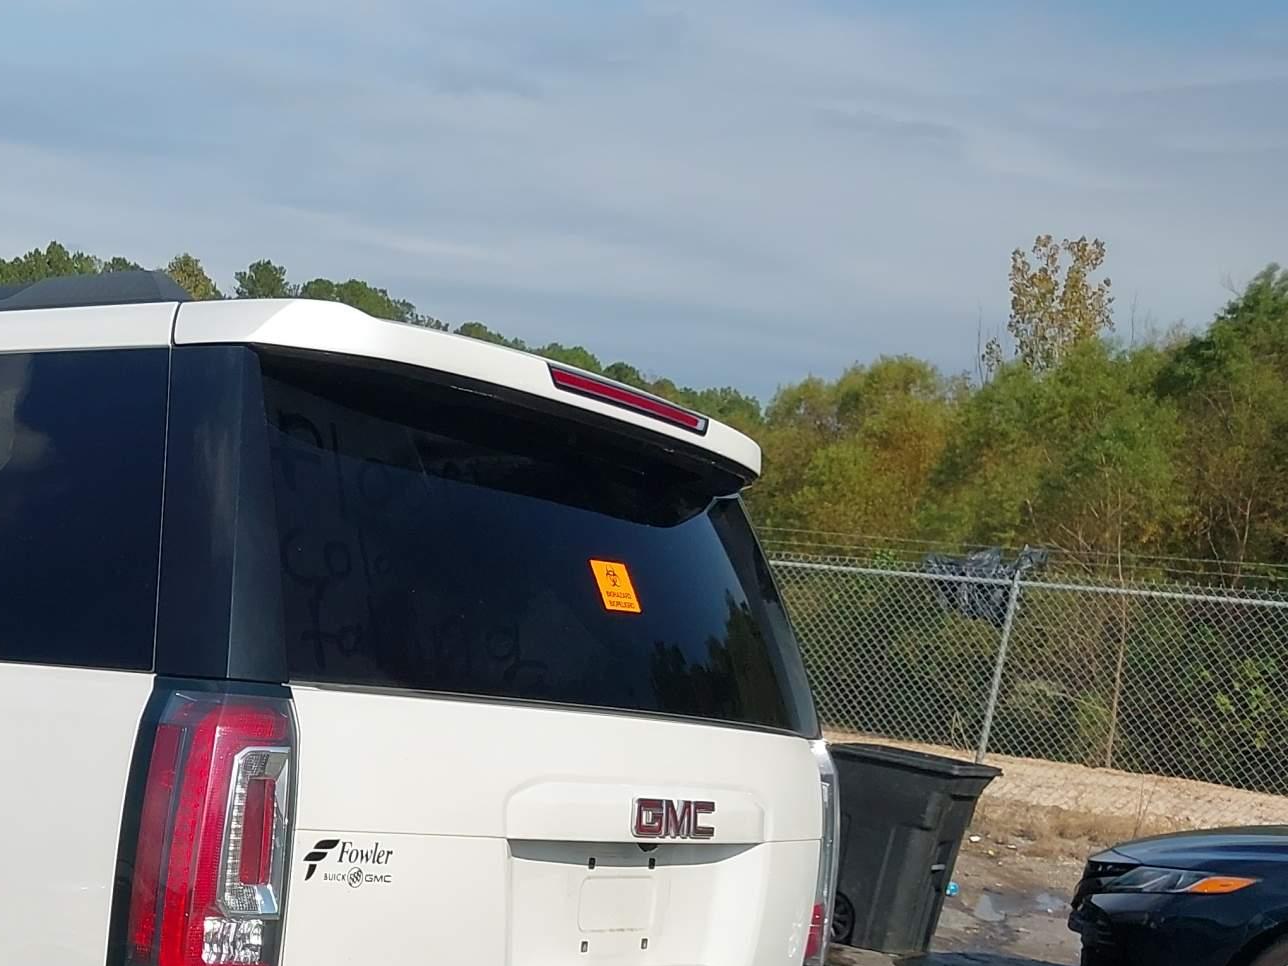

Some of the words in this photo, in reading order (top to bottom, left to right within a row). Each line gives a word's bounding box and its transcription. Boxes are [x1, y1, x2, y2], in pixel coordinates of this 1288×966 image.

[631, 797, 715, 840] GMC
[337, 841, 394, 865] Fowler
[323, 872, 347, 882] BUICK
[365, 873, 392, 883] GMC
